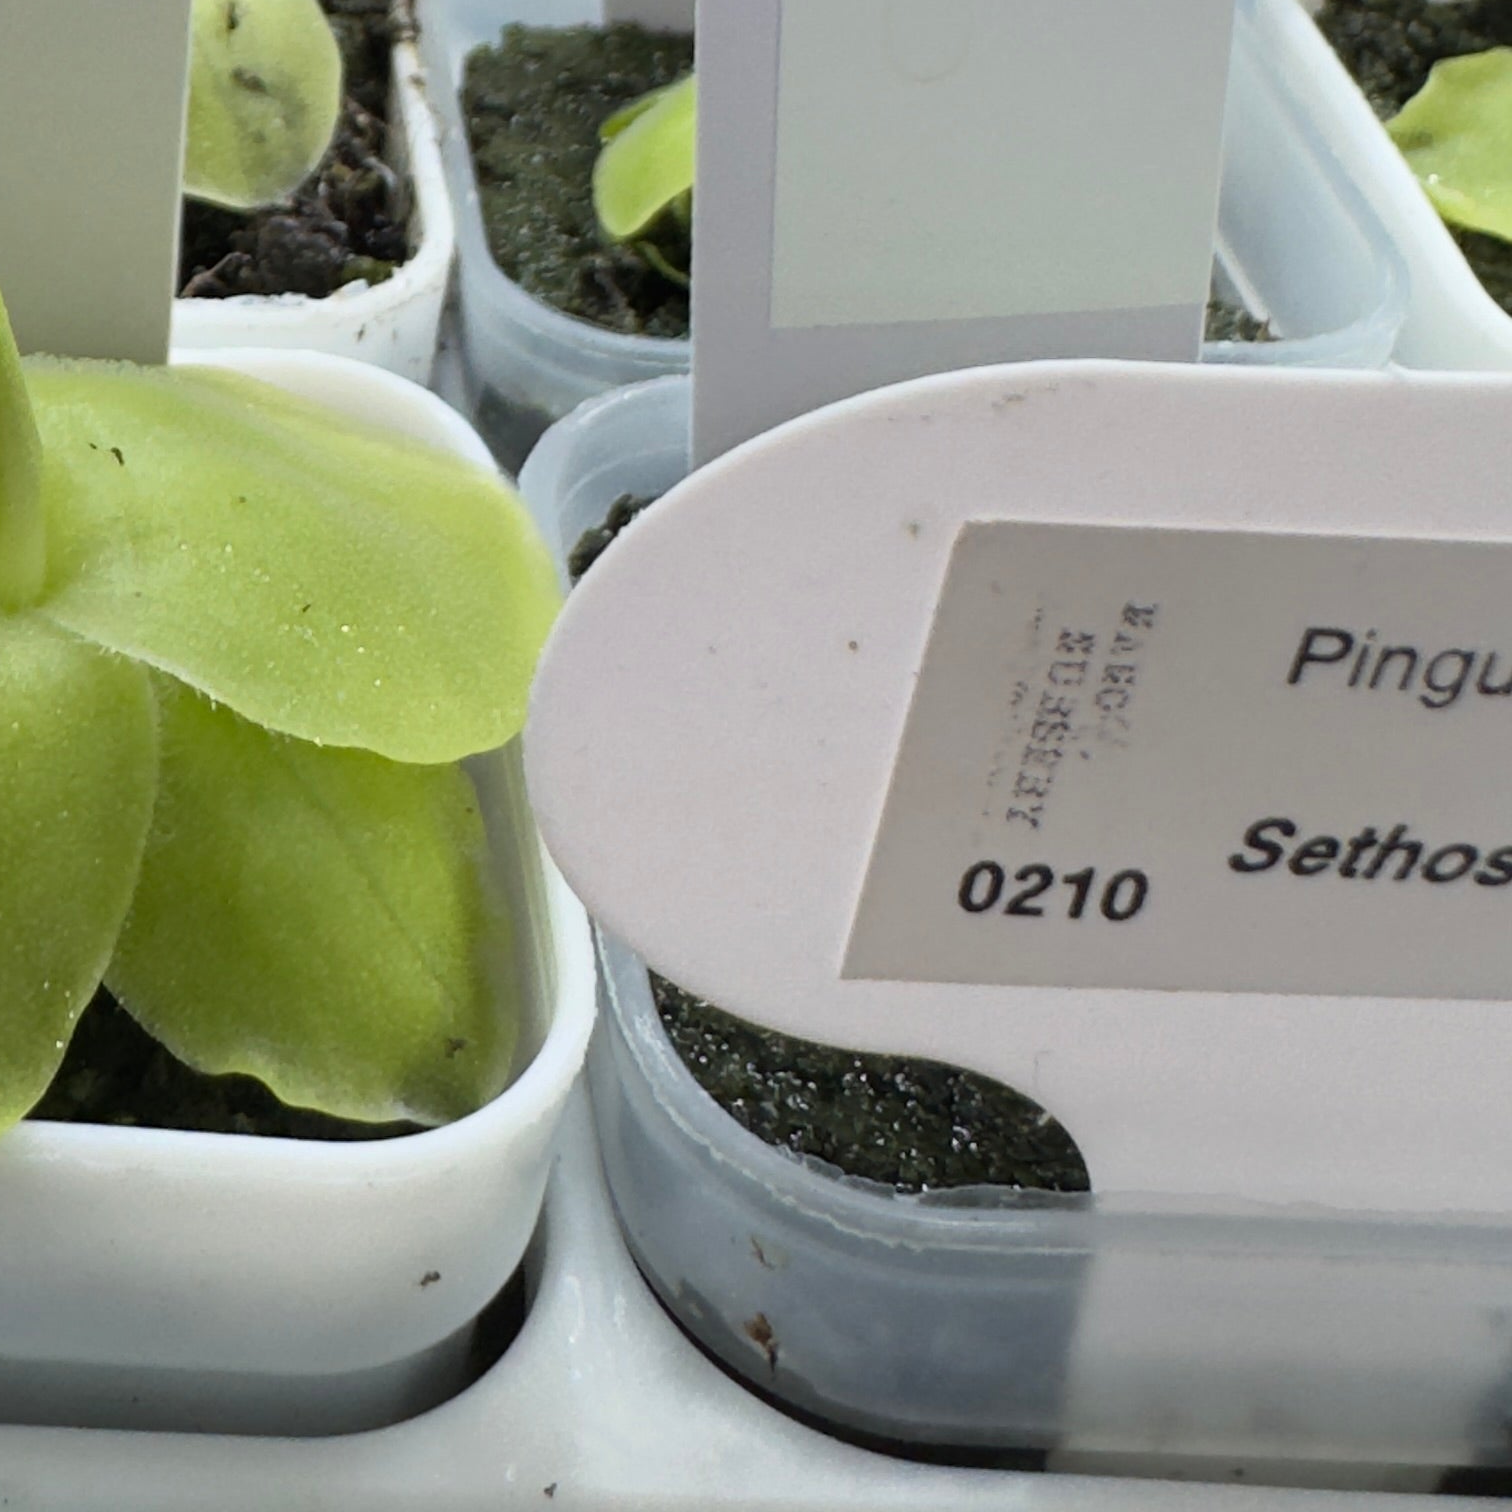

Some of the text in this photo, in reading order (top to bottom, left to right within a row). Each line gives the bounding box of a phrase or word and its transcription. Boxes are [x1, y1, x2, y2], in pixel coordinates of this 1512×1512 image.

[1288, 627, 1512, 709] Pingu
[1229, 817, 1512, 889] Sethos
[958, 860, 1148, 921] 0210
